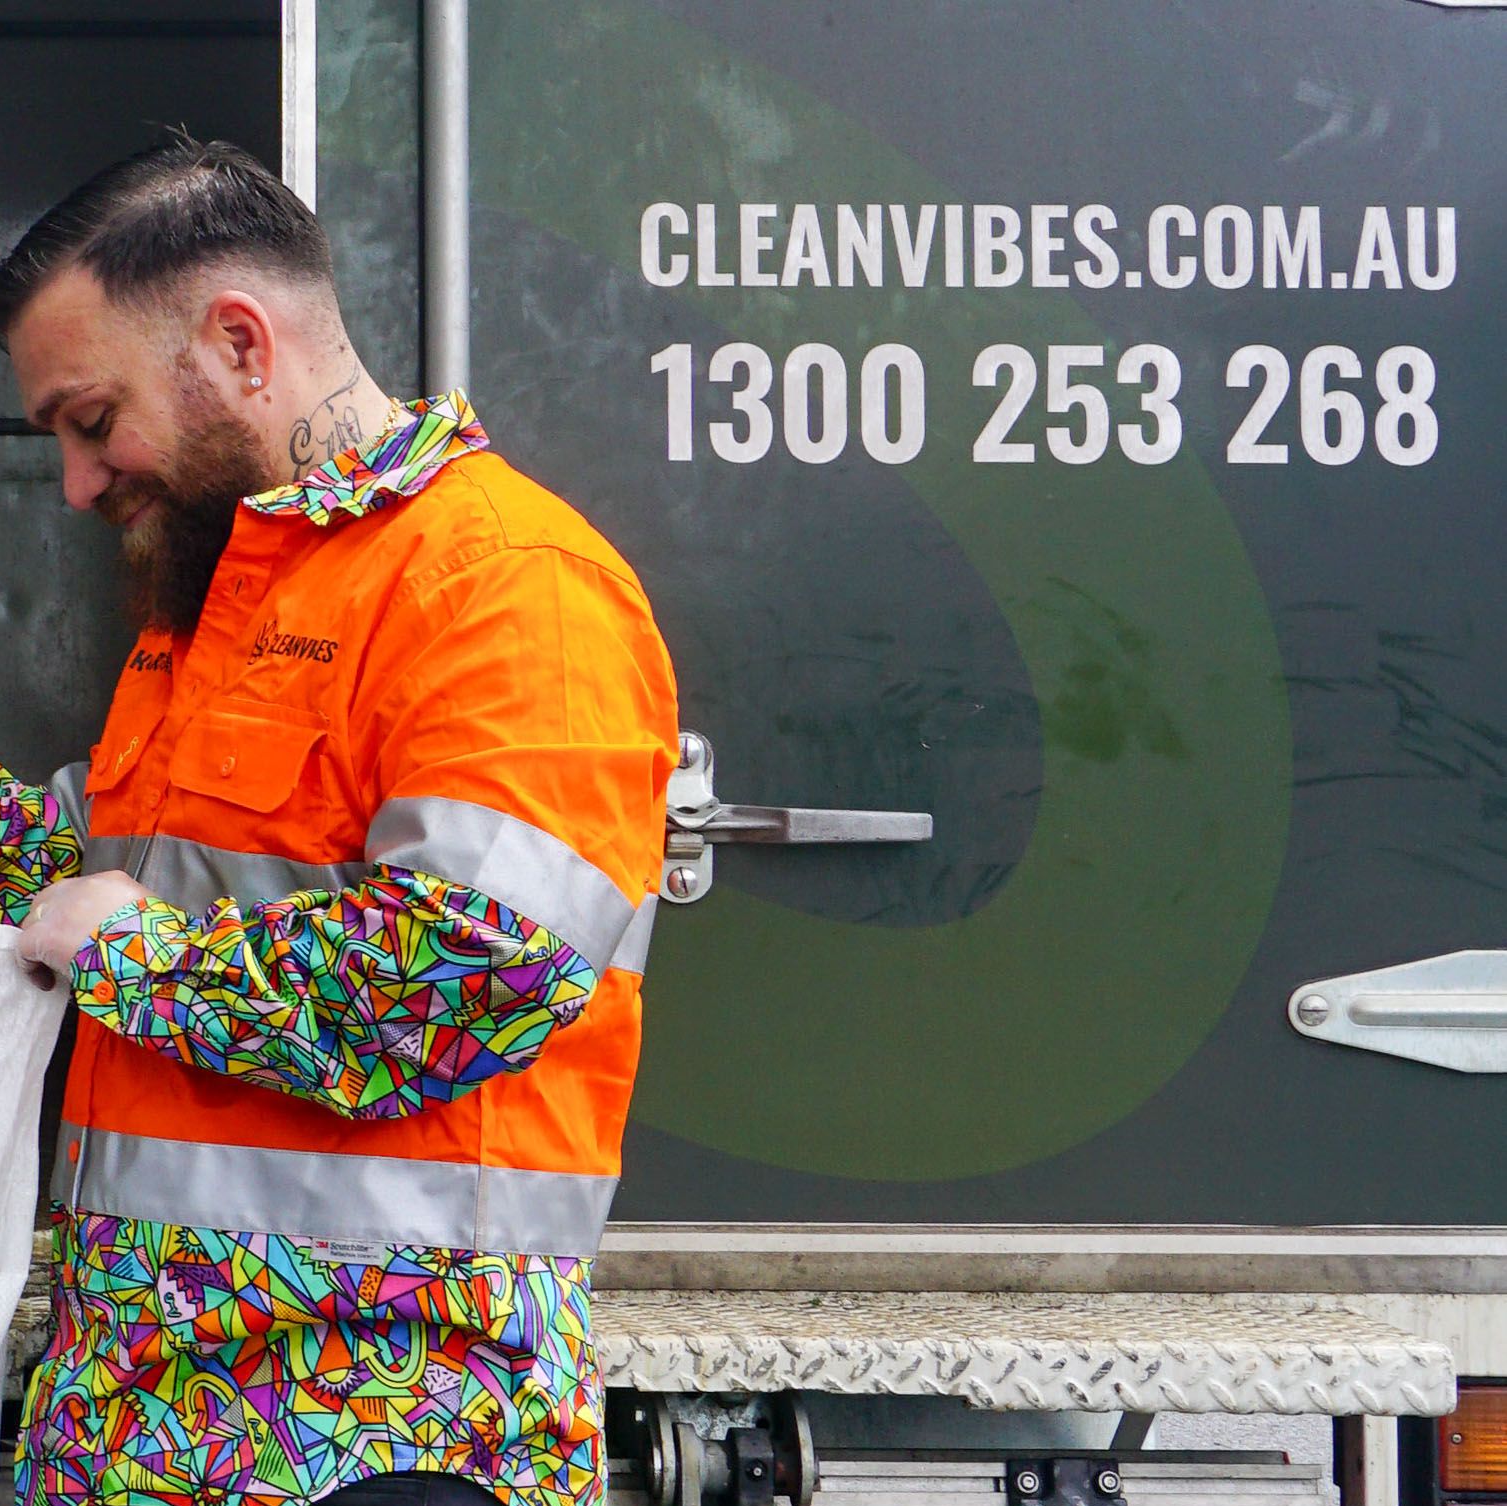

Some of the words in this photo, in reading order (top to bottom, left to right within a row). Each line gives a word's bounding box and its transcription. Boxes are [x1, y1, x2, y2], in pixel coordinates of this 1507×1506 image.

[639, 202, 1458, 290] CLEANVIBES.COM.AU
[650, 343, 926, 464] 1300
[972, 343, 1182, 464] 253
[1225, 345, 1440, 466] 268
